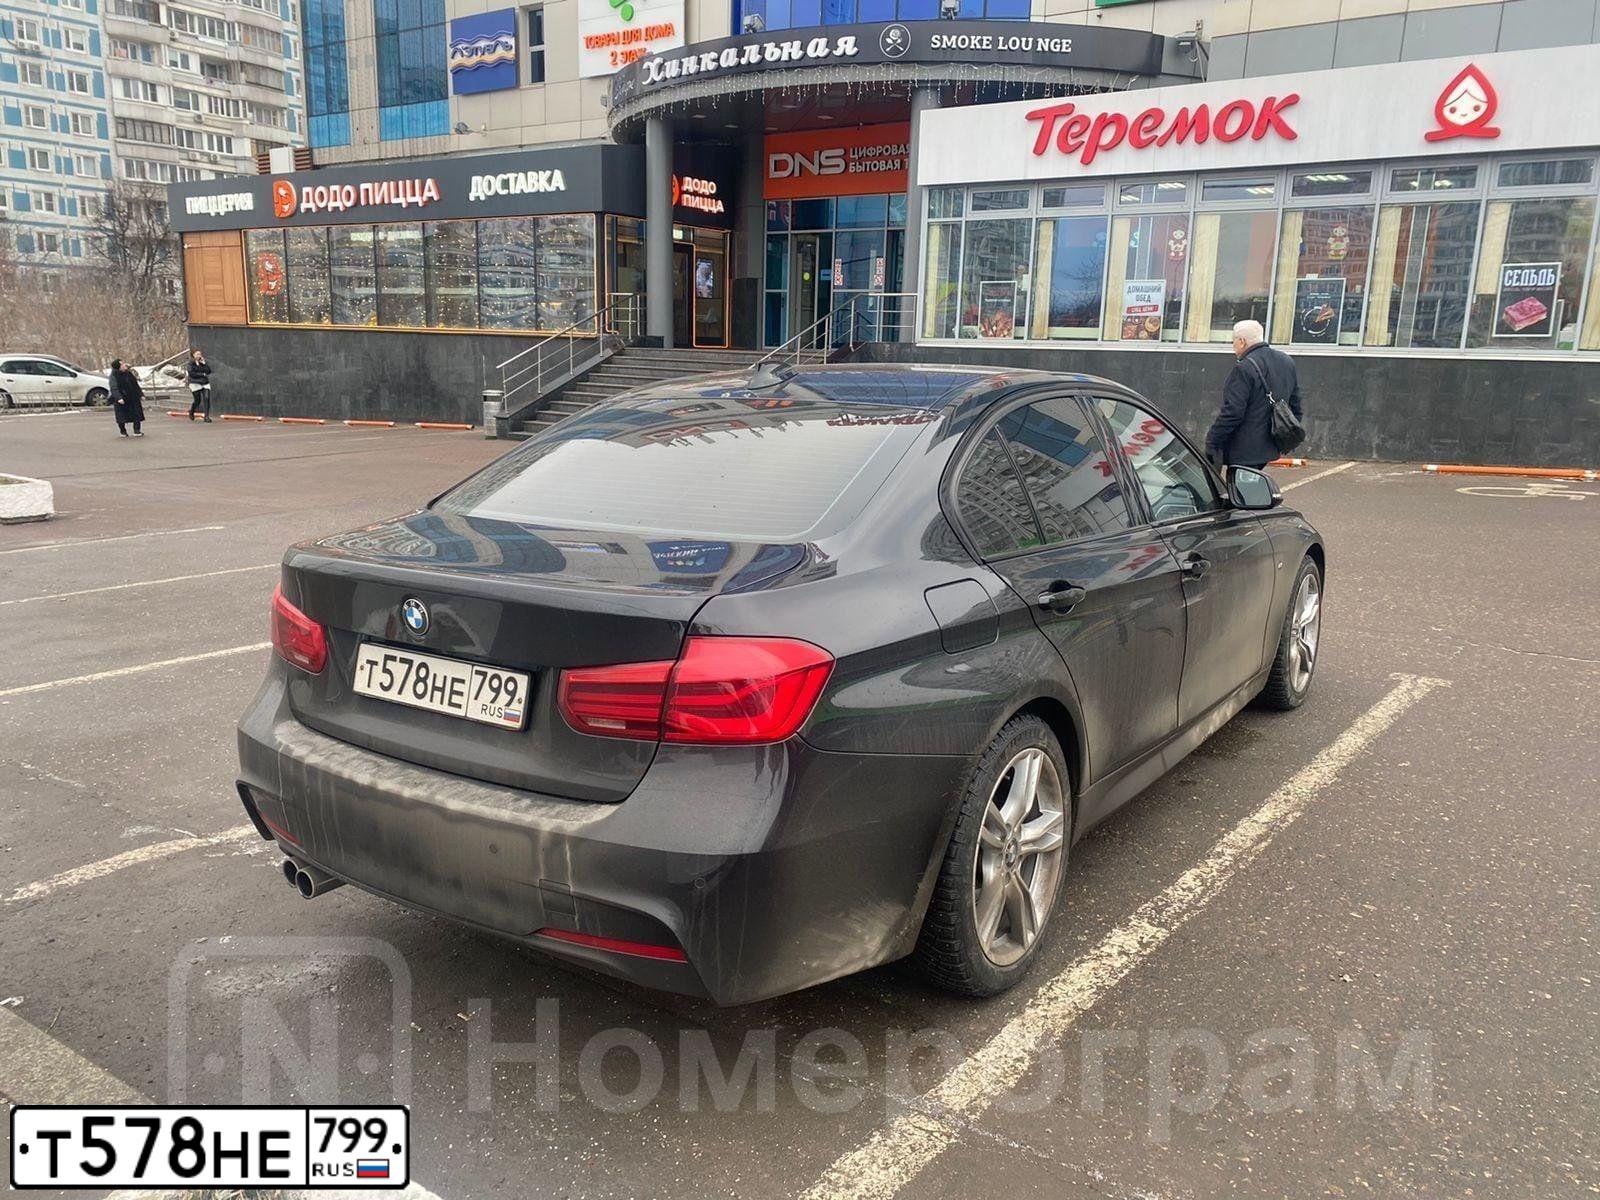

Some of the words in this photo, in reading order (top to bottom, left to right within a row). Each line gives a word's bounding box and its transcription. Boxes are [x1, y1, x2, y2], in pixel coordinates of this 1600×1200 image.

[584, 31, 620, 49] ТОВАРЫ
[622, 28, 642, 45] ДЛЯ
[645, 22, 676, 42] ДОМА
[931, 35, 993, 50] SMOKE
[609, 49, 618, 66] 2
[642, 36, 859, 85] Хинкальная
[1025, 93, 1301, 166] Теремок
[768, 148, 847, 179] DNS
[849, 158, 901, 173] БЫТОВАЯ
[301, 184, 358, 213] ДОДО
[360, 178, 440, 209] ПИЦЦА
[468, 169, 566, 201] ДОСТАВКА
[682, 176, 717, 196] ДОДО
[185, 192, 254, 216] ПИЦЦЕРИЯ
[681, 193, 725, 214] ПИЦЦА
[1504, 268, 1556, 287] СЕЛЬДЬ
[365, 653, 466, 710] Т578НЕ
[473, 669, 519, 708] 799
[480, 703, 504, 719] RUS
